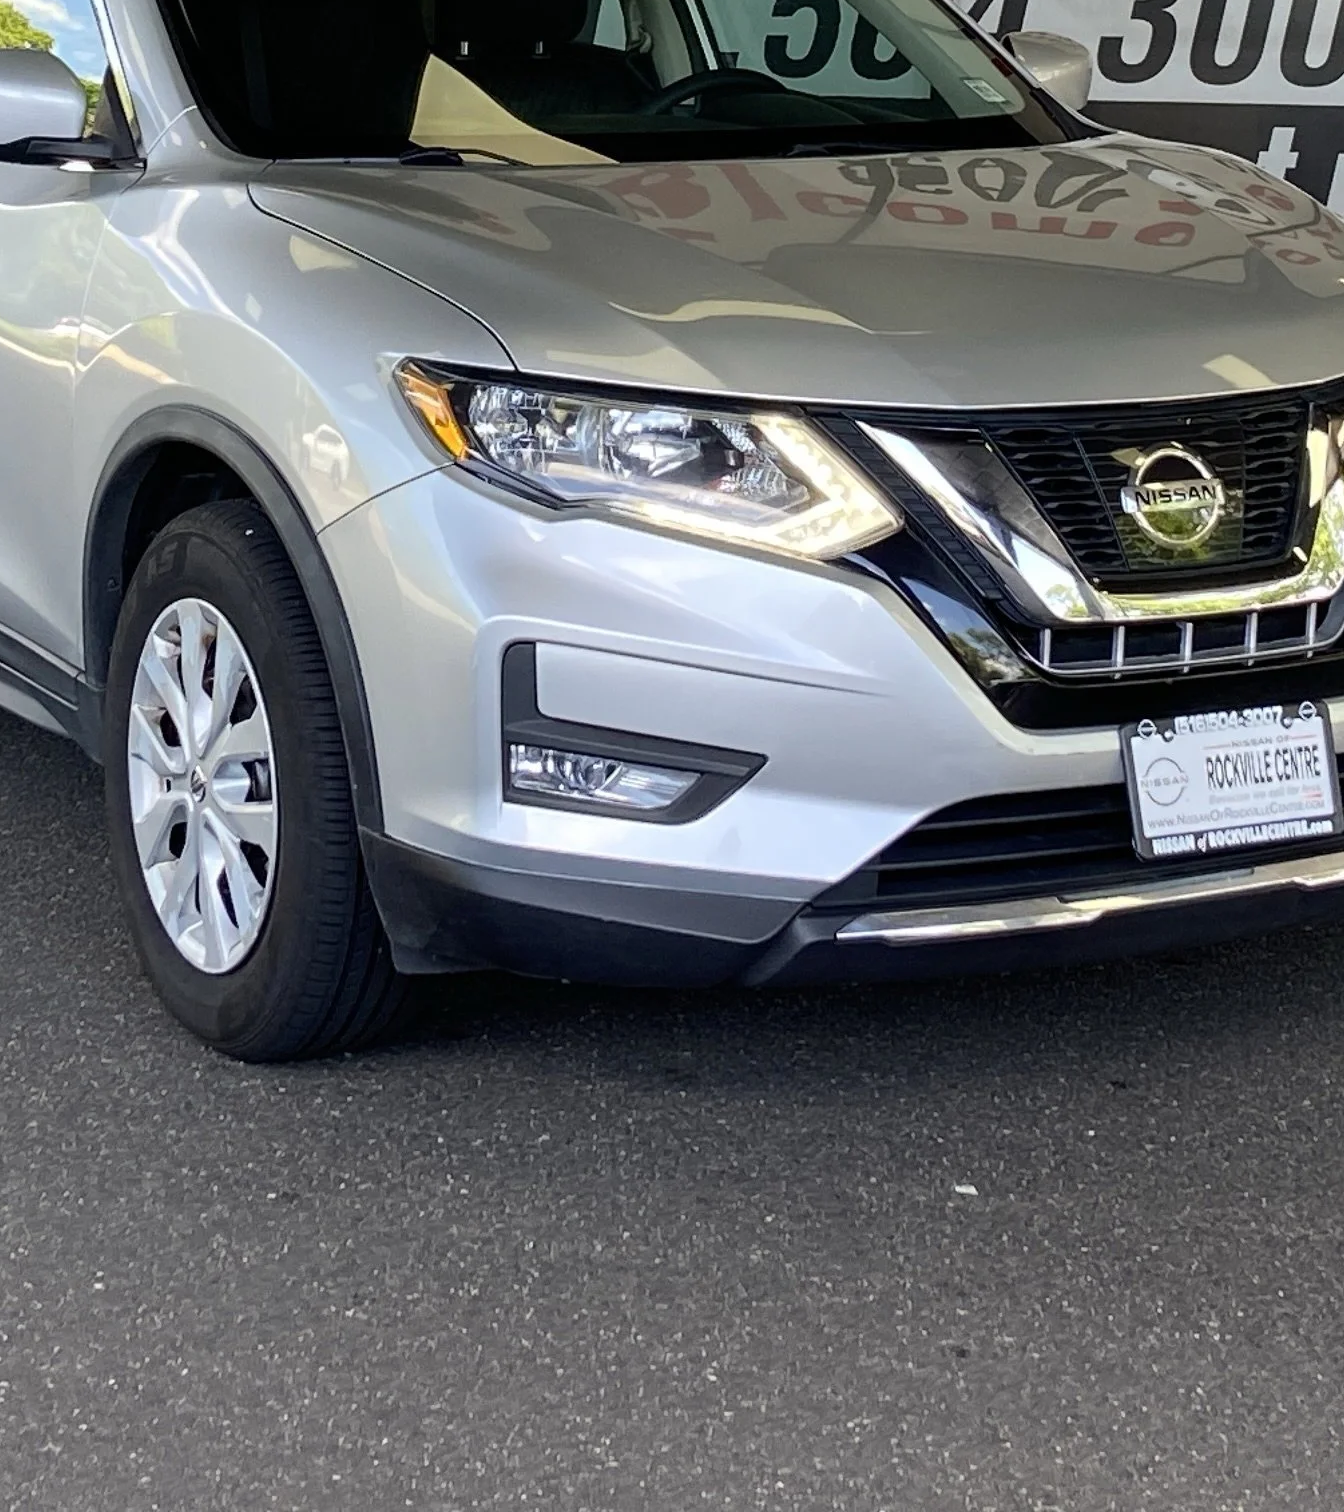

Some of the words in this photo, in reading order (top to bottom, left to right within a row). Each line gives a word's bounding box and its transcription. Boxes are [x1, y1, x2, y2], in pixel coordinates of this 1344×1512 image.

[1135, 485, 1216, 507] NISSAN
[1206, 750, 1273, 789] ROCKVILLE
[1275, 745, 1321, 782] CENTRE
[1140, 775, 1189, 788] NISSAN
